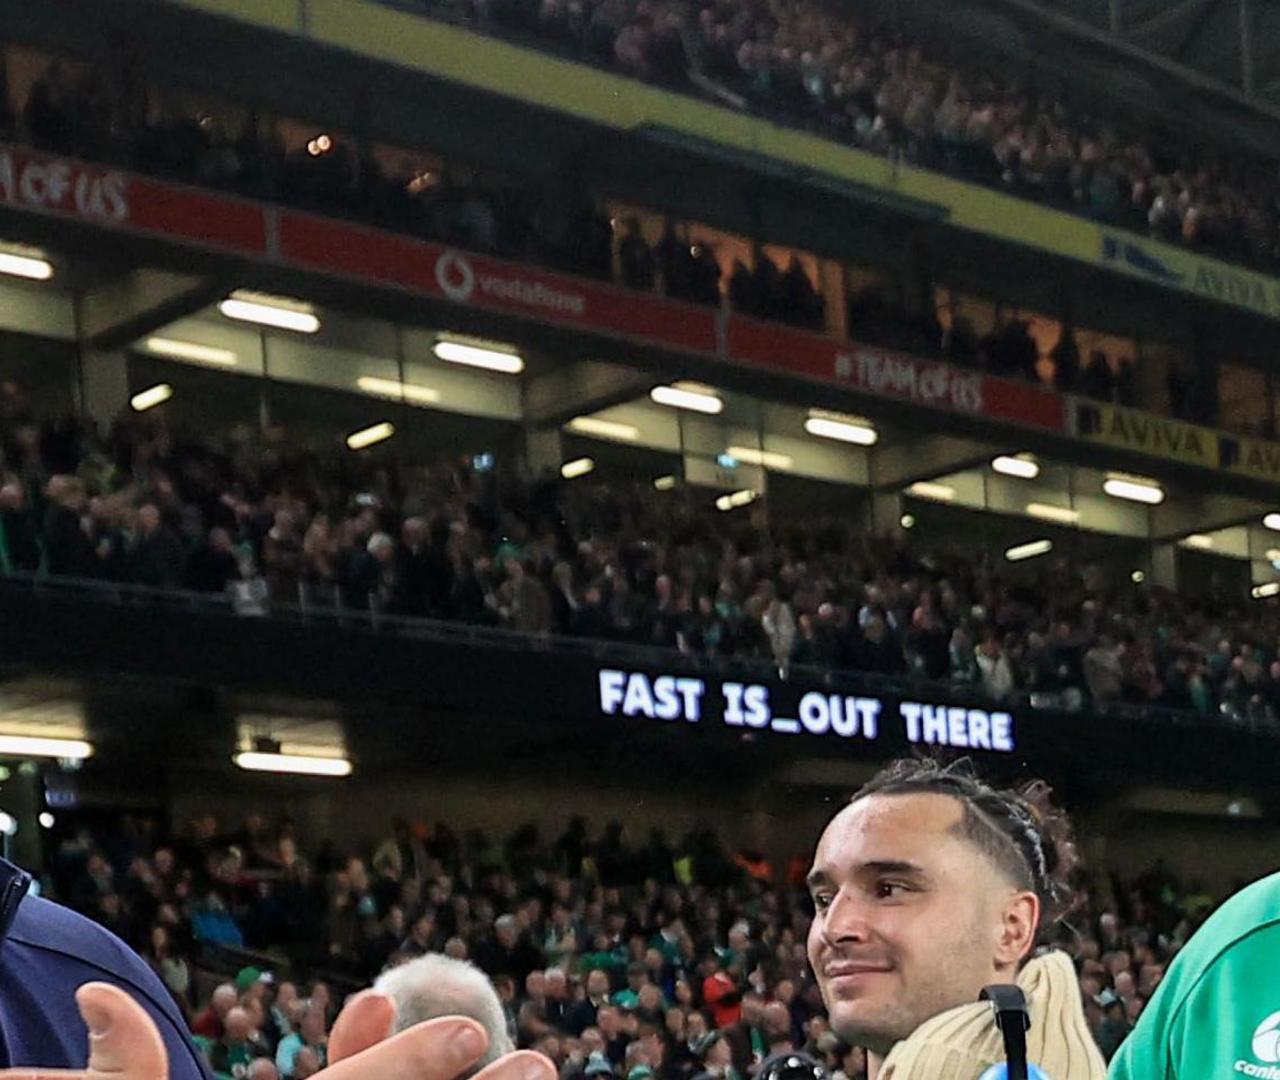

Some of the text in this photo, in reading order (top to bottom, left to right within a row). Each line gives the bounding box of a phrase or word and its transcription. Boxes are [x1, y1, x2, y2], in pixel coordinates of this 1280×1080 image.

[1111, 405, 1205, 456] AVIVA
[598, 669, 705, 722] FAST
[899, 701, 1015, 752] THERE
